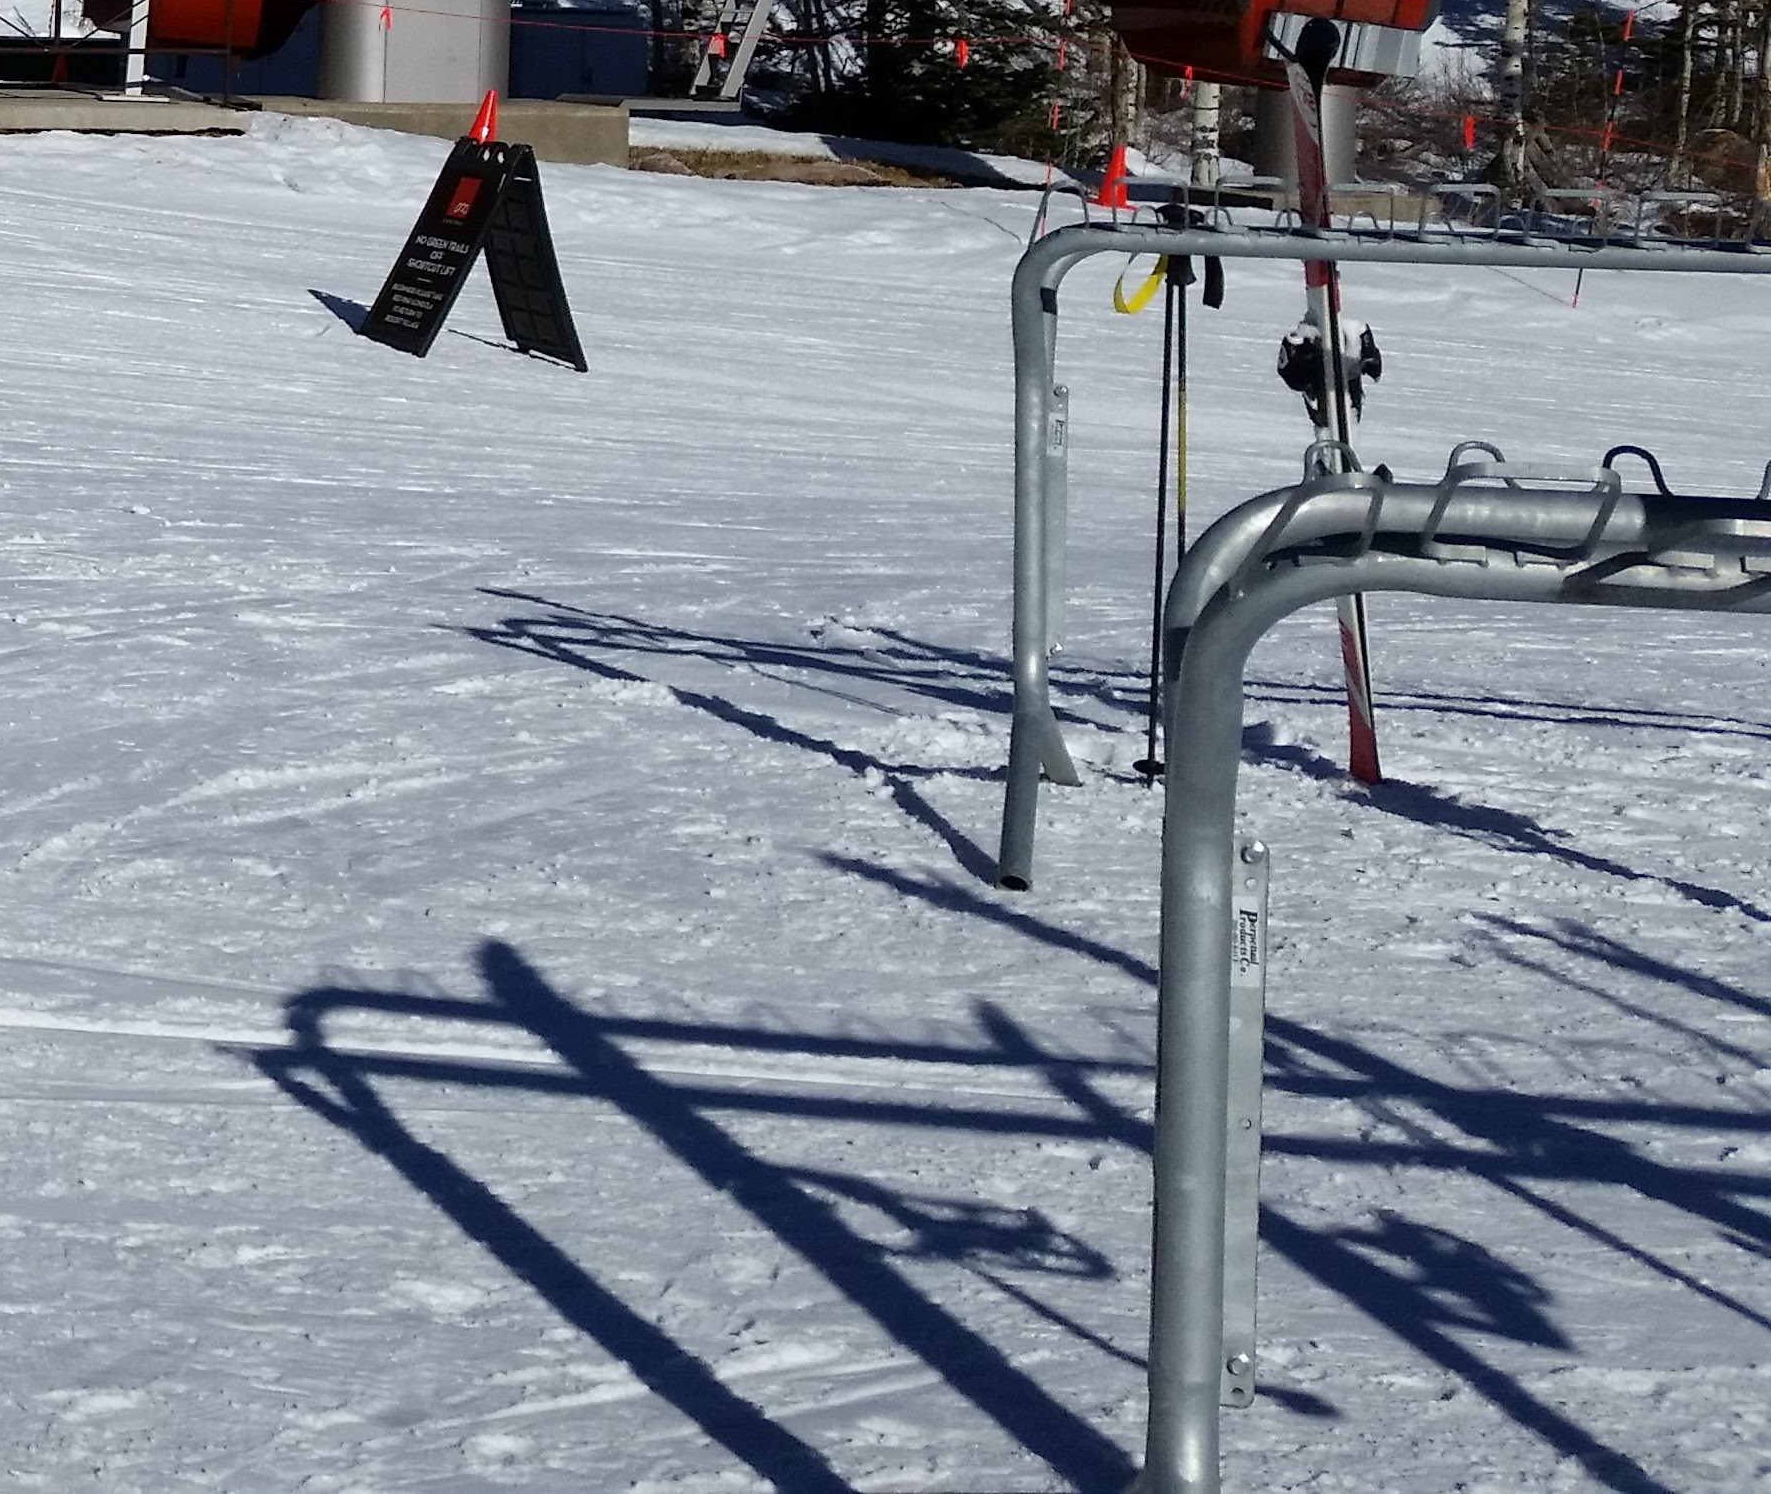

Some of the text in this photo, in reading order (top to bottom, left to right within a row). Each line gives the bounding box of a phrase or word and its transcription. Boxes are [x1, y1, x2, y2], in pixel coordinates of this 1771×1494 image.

[415, 235, 470, 254] NO GREEN TRAILS
[406, 257, 457, 276] SHORTCUT LIFT
[1240, 909, 1259, 965] Perpetual
